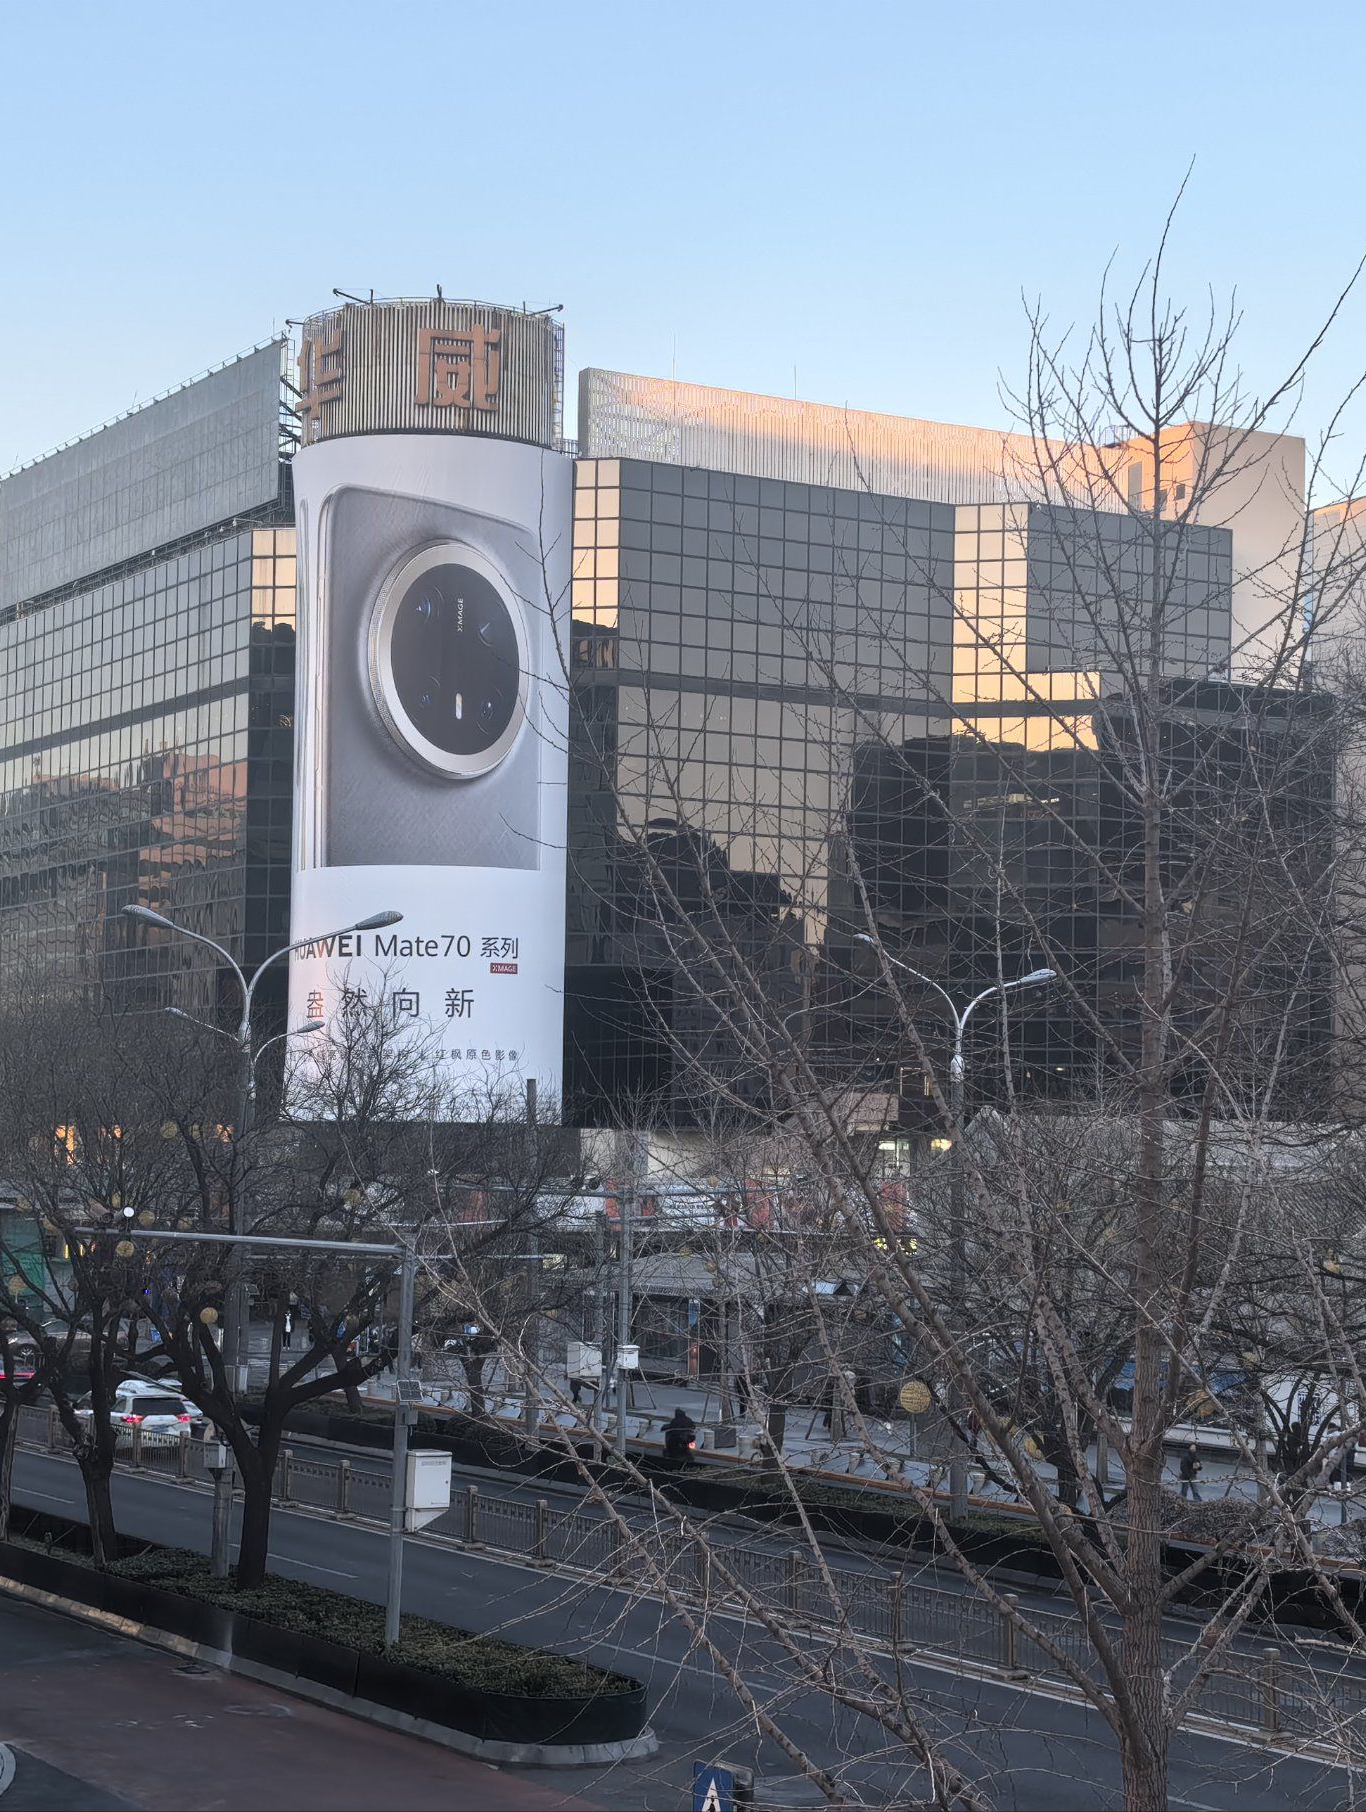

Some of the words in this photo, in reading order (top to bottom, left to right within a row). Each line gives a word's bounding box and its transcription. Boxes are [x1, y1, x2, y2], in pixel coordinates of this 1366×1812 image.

[480, 937, 519, 960] 系列
[307, 987, 475, 1019] 盎然向新
